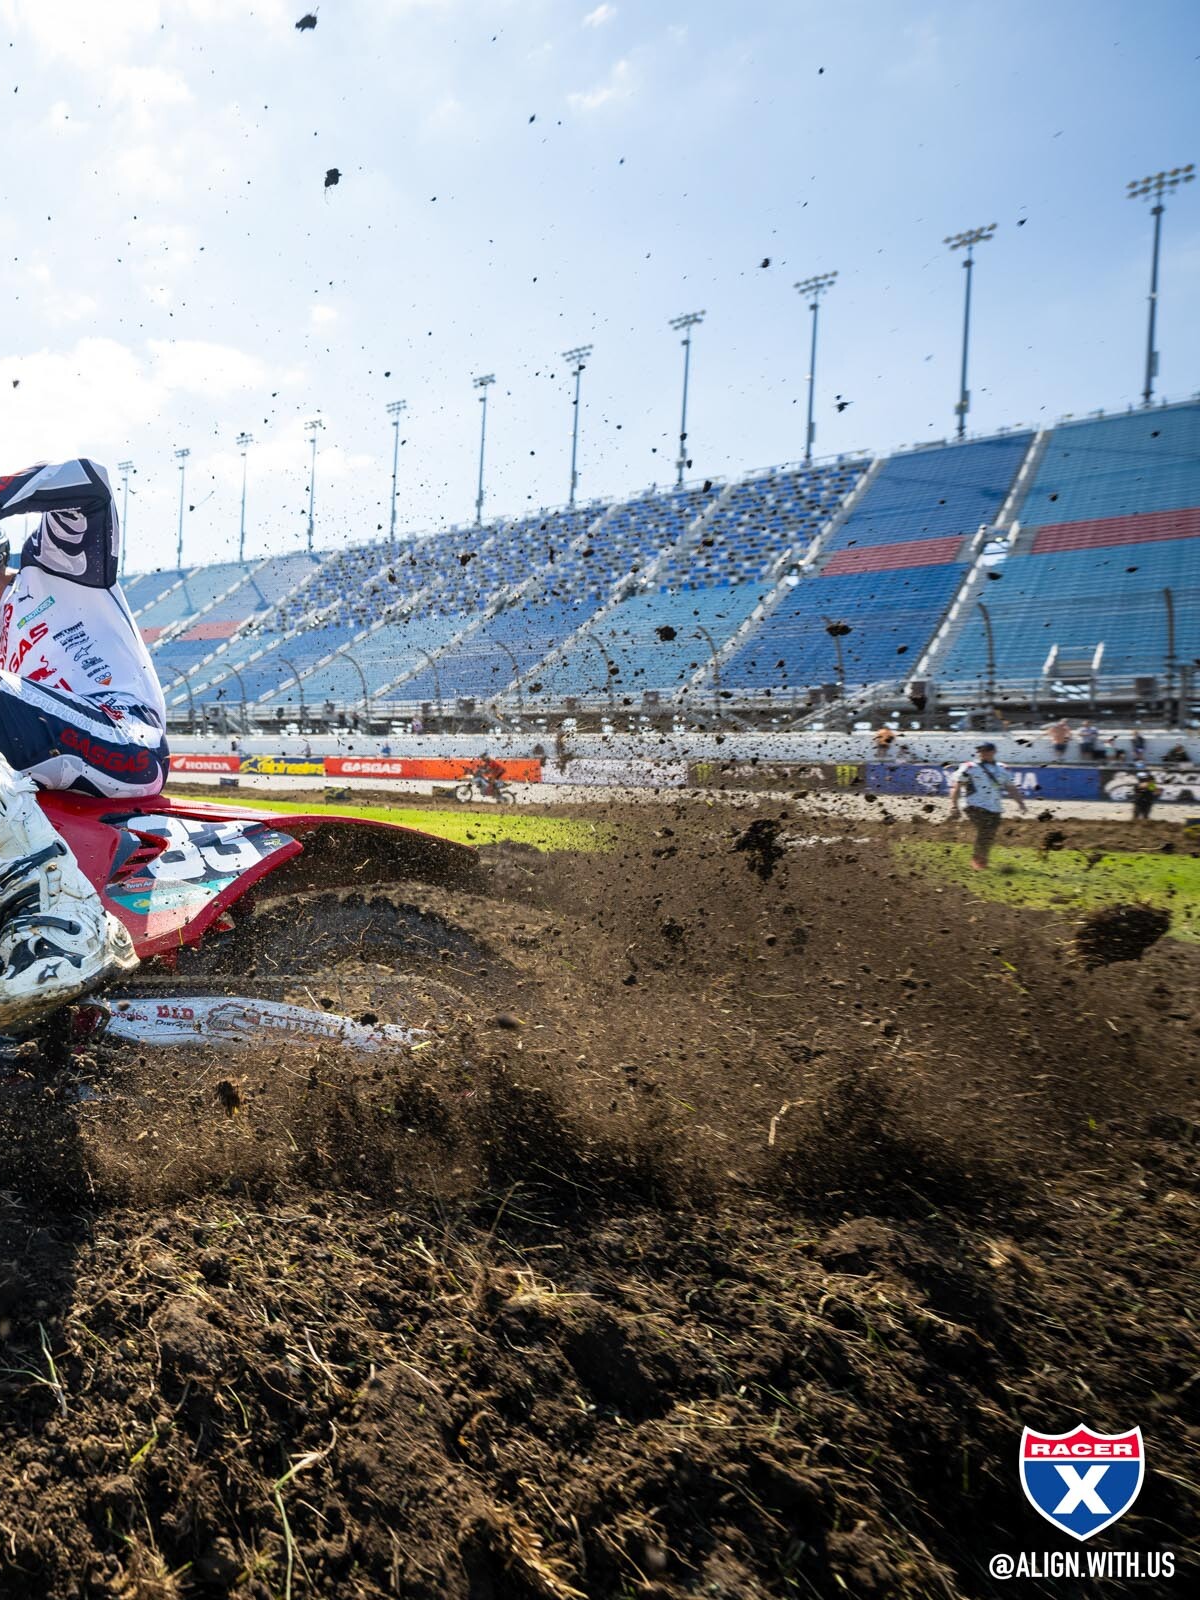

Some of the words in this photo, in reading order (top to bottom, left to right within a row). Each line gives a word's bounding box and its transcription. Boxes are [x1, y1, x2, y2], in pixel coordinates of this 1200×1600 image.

[60, 728, 149, 772] GASGAS
[185, 760, 231, 771] HONDA
[341, 761, 402, 774] GASGAS
